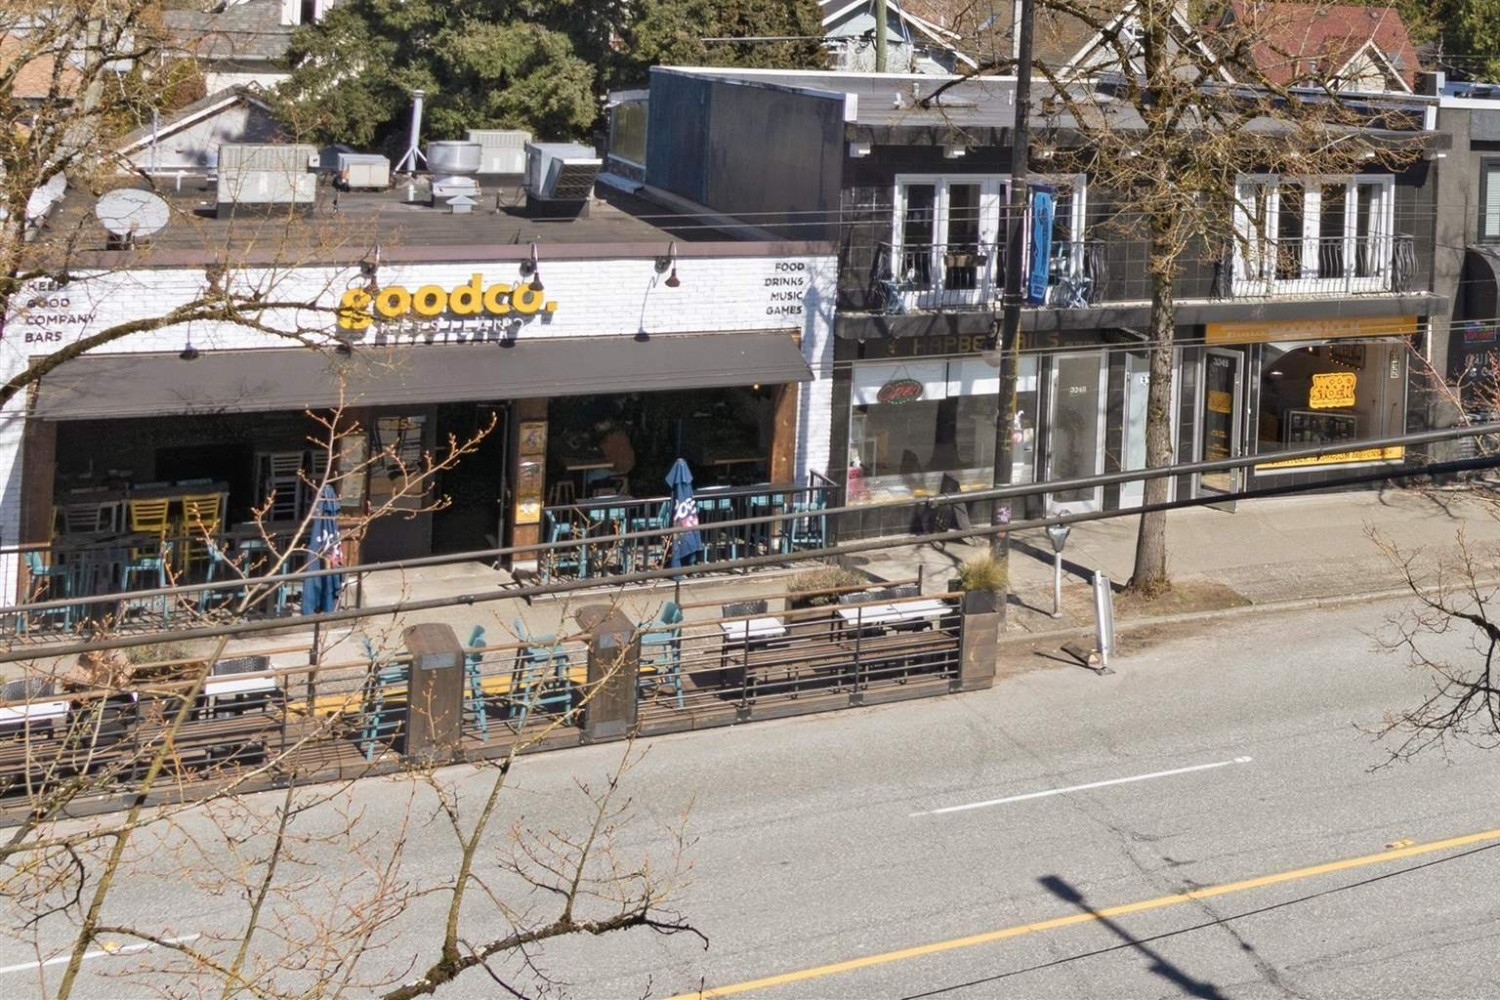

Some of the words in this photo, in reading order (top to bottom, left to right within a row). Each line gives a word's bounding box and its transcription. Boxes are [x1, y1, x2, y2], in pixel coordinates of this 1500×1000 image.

[775, 262, 805, 272] FOOD
[764, 277, 804, 287] DRINKS
[338, 272, 558, 330] goodco.
[770, 291, 803, 301] MUSIC
[766, 306, 802, 316] GAMES
[26, 313, 96, 326] COMPANY
[25, 331, 63, 343] BARS
